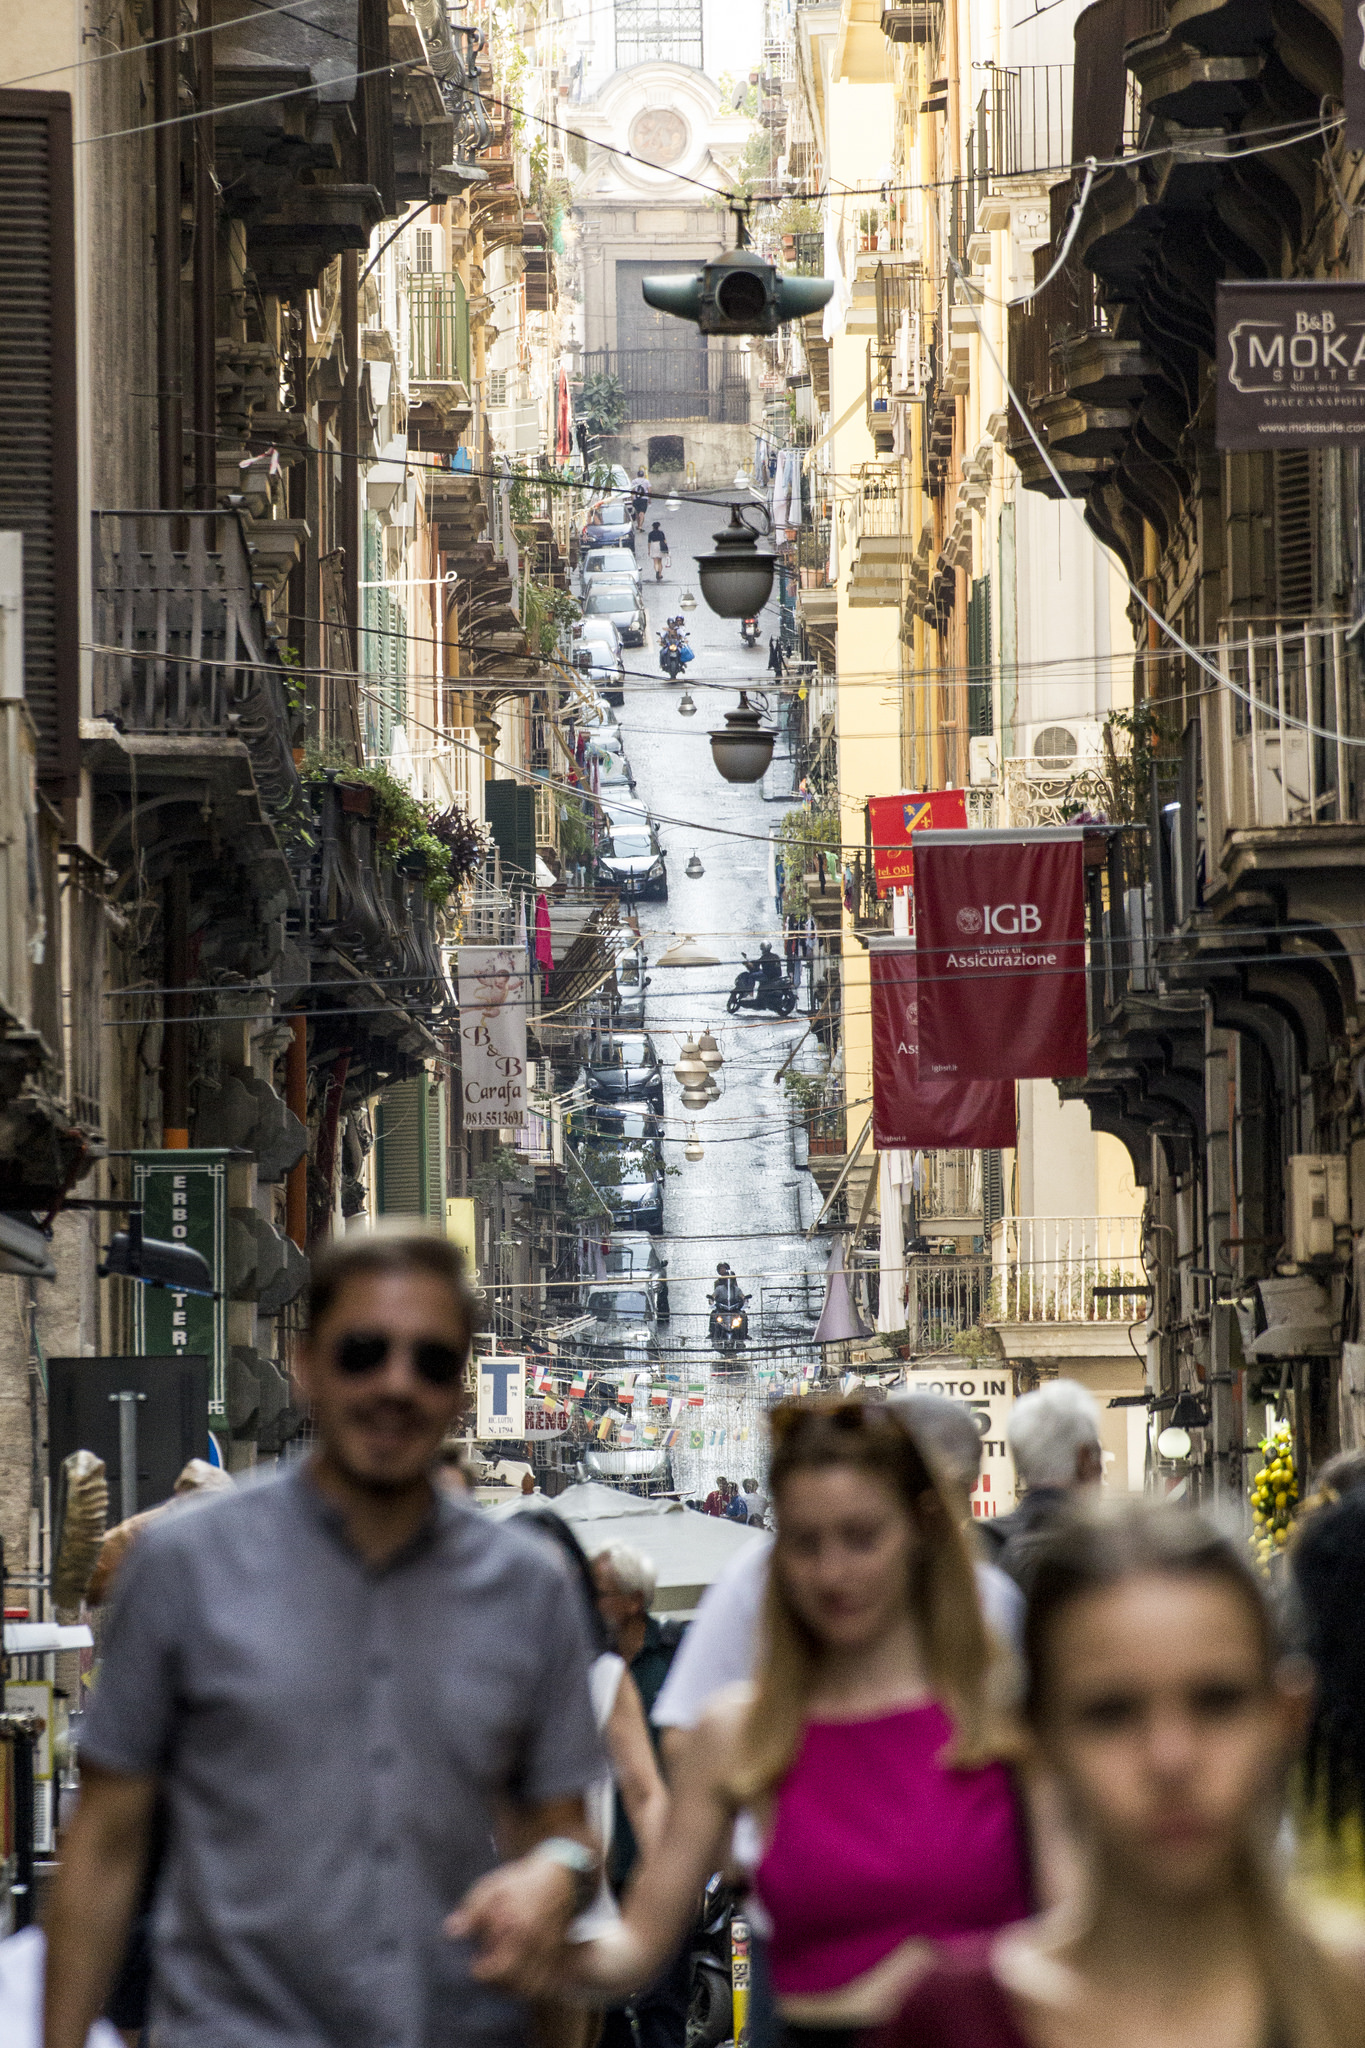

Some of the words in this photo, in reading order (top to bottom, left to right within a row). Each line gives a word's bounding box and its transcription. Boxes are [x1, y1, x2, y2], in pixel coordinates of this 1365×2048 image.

[1296, 311, 1336, 333] B&B
[1273, 369, 1358, 382] SUITE
[893, 865, 910, 875] 081
[983, 904, 1042, 935] IGB
[946, 953, 1057, 968] Assicurazione
[465, 1080, 522, 1107] Carafa
[915, 1381, 976, 1396] FOTO
[983, 1381, 1006, 1396] IN
[525, 1411, 568, 1430] RENO
